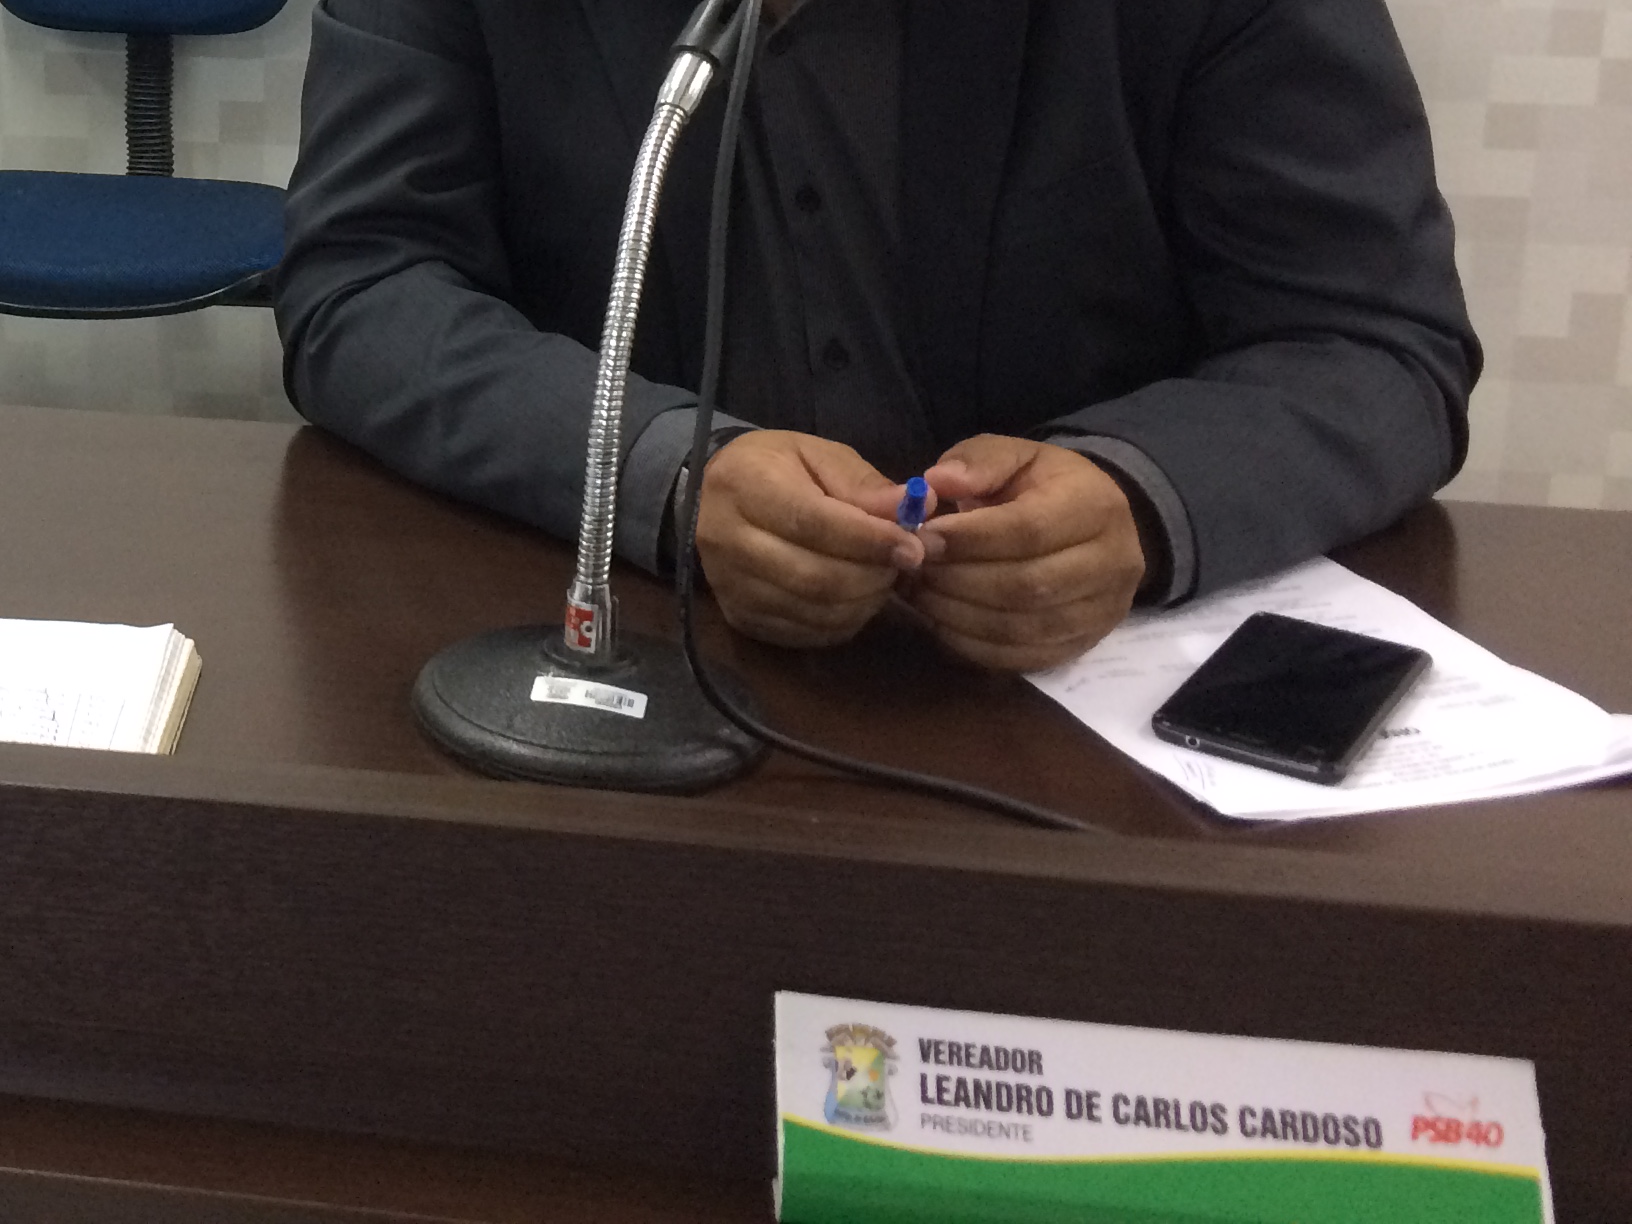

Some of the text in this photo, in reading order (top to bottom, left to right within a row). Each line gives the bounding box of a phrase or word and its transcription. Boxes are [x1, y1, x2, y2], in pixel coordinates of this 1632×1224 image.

[918, 1037, 1044, 1076] VEREADOR
[920, 1073, 1054, 1117] LEANDRO
[1064, 1087, 1102, 1123] DE
[1112, 1092, 1228, 1135] CARLOS
[1239, 1105, 1383, 1149] CARDOSO
[920, 1112, 1034, 1143] PRESIDENTE
